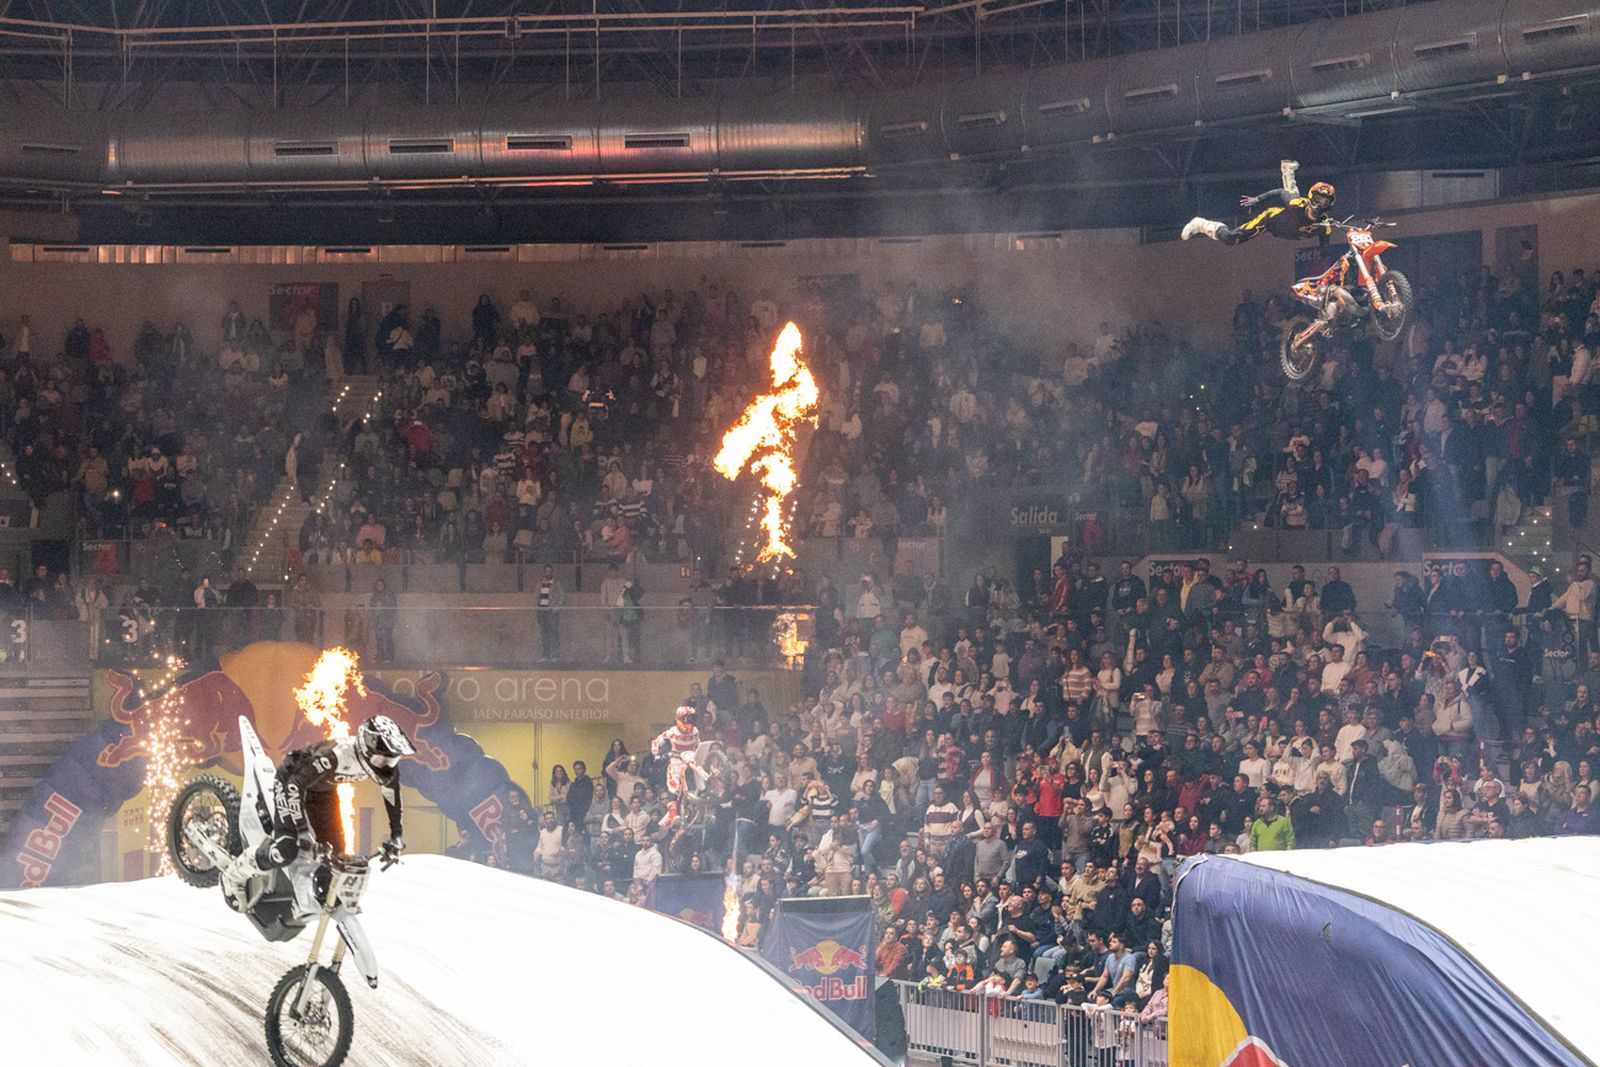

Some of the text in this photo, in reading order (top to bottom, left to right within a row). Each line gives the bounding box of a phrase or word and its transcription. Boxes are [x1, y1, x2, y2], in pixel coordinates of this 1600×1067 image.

[1011, 505, 1057, 524] Salida
[82, 543, 112, 552] Sector
[10, 619, 27, 643] 3
[121, 619, 138, 643] 3
[1544, 647, 1569, 658] Sector
[495, 677, 610, 702] arena
[555, 708, 610, 720] INTERIOR
[24, 792, 83, 860] Bull
[828, 975, 868, 1000] Bull
